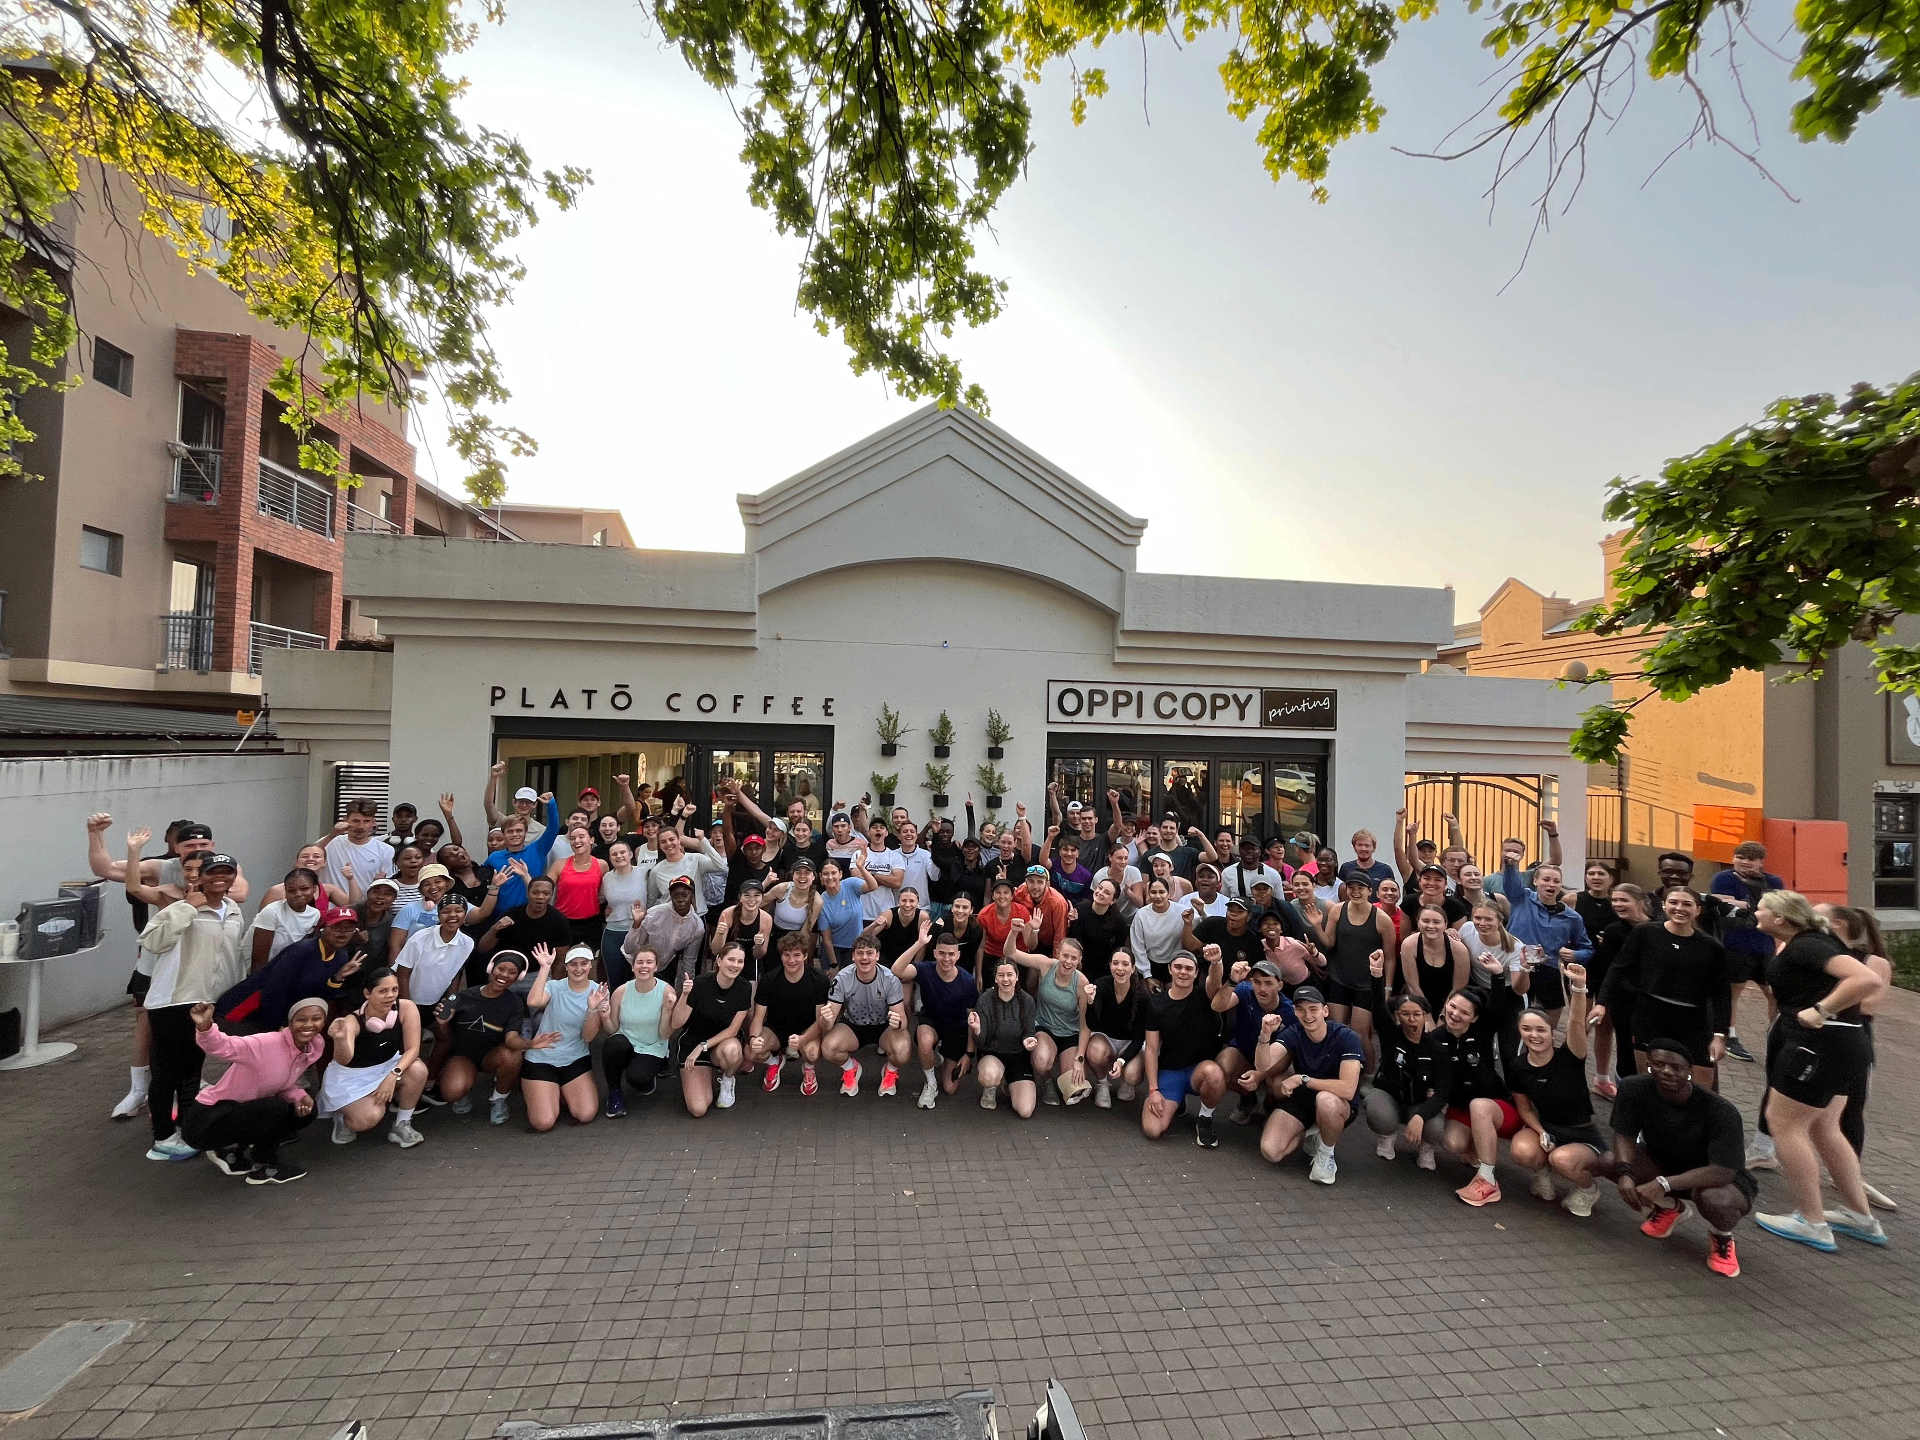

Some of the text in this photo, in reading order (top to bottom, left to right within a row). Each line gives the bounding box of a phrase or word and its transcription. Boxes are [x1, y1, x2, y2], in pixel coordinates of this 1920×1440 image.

[665, 692, 835, 717] COFFEE
[1057, 687, 1254, 721] OPPI COPY
[1268, 696, 1330, 722] printing
